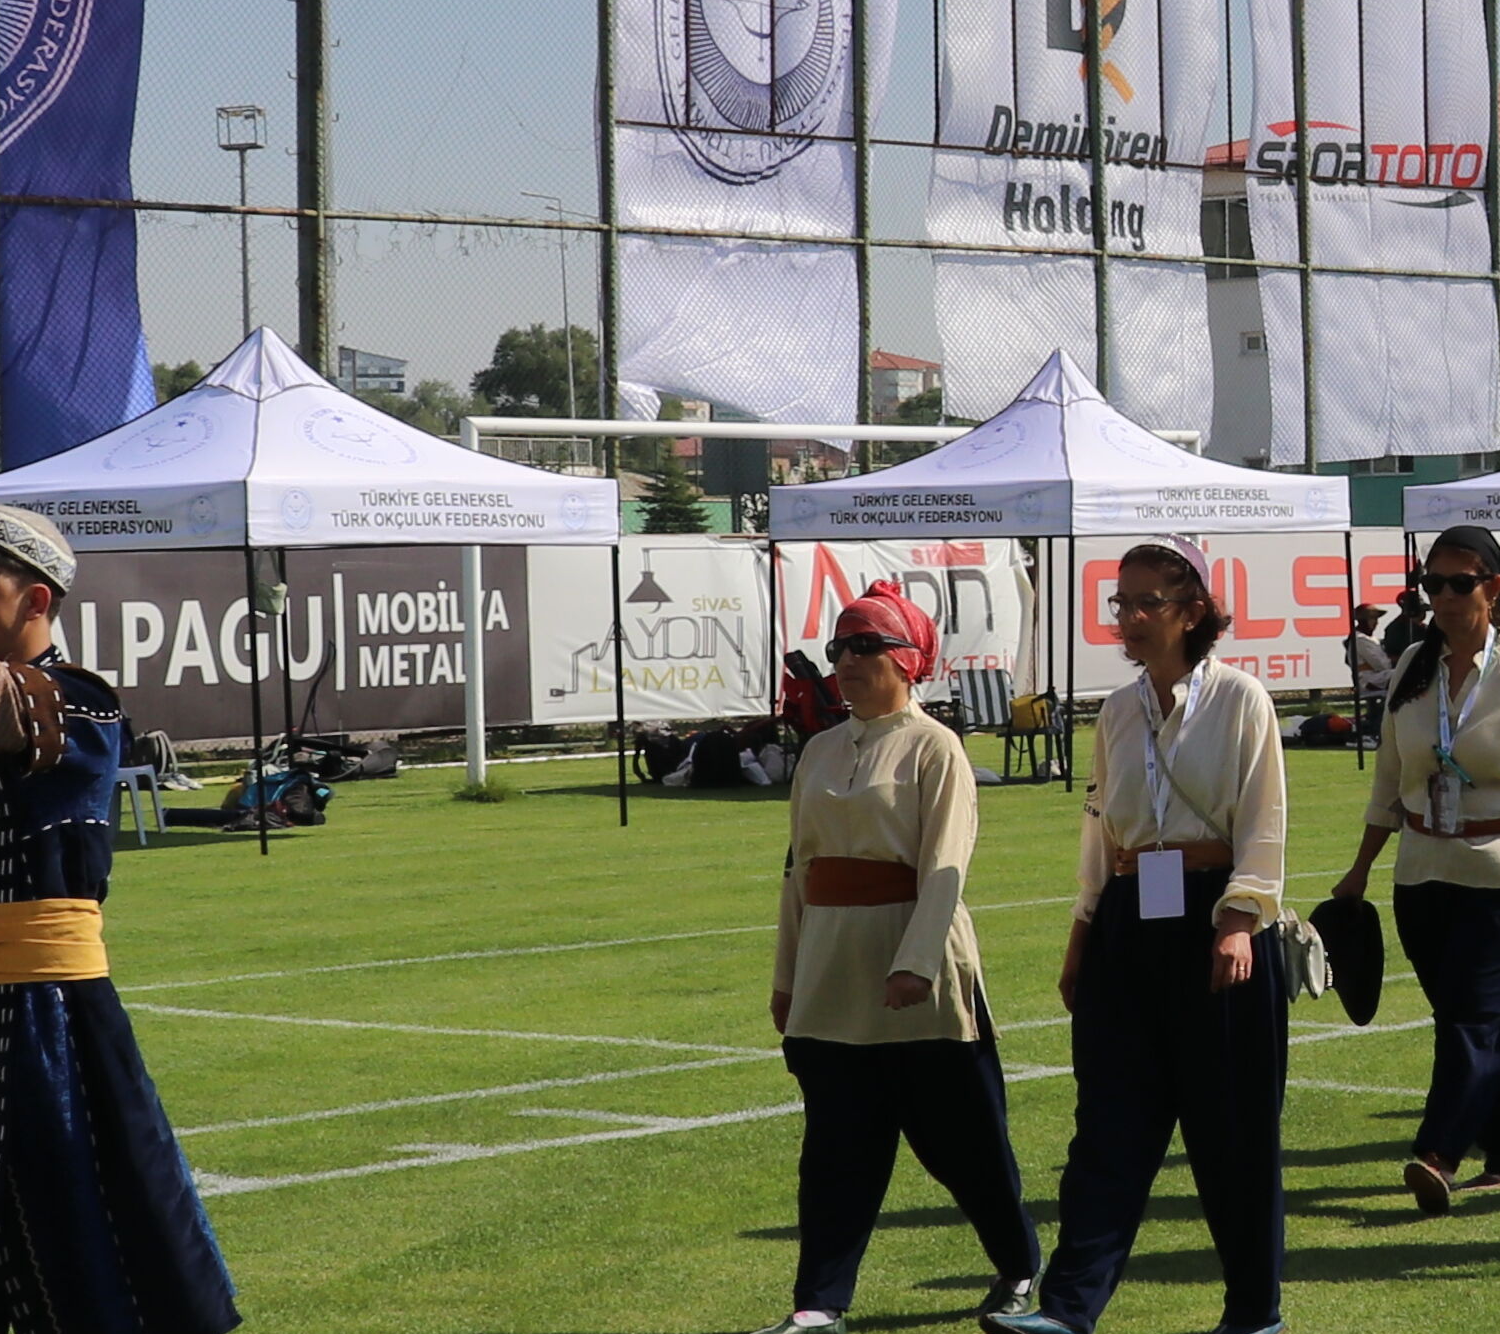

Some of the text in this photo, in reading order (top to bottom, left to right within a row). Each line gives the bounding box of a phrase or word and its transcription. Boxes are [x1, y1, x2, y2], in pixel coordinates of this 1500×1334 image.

[1004, 182, 1146, 252] Holdng
[360, 489, 513, 508] TÜRKİYE GELENEKSEL
[852, 492, 976, 507] TÜRKİYE GELENEKSEL
[1156, 486, 1270, 502] TÜRKİYE GELENEKSEL
[58, 500, 142, 515] GELENEKSEL
[1135, 504, 1294, 521] TÜRK OKÇULUK FEDERASYONU
[1465, 507, 1494, 521] TÜRK
[77, 518, 173, 535] FEDERASYONU
[332, 509, 546, 530] TÜRK OKÇULUK FEDERASYONU
[830, 510, 1003, 526] TÜRK OKÇULUK FEDERASYONU
[357, 580, 510, 636] MOBİLA
[692, 595, 743, 613] SİVAS
[359, 643, 467, 688] METAL
[1266, 649, 1310, 680] ŞTİ
[589, 664, 727, 694] LAMBA
